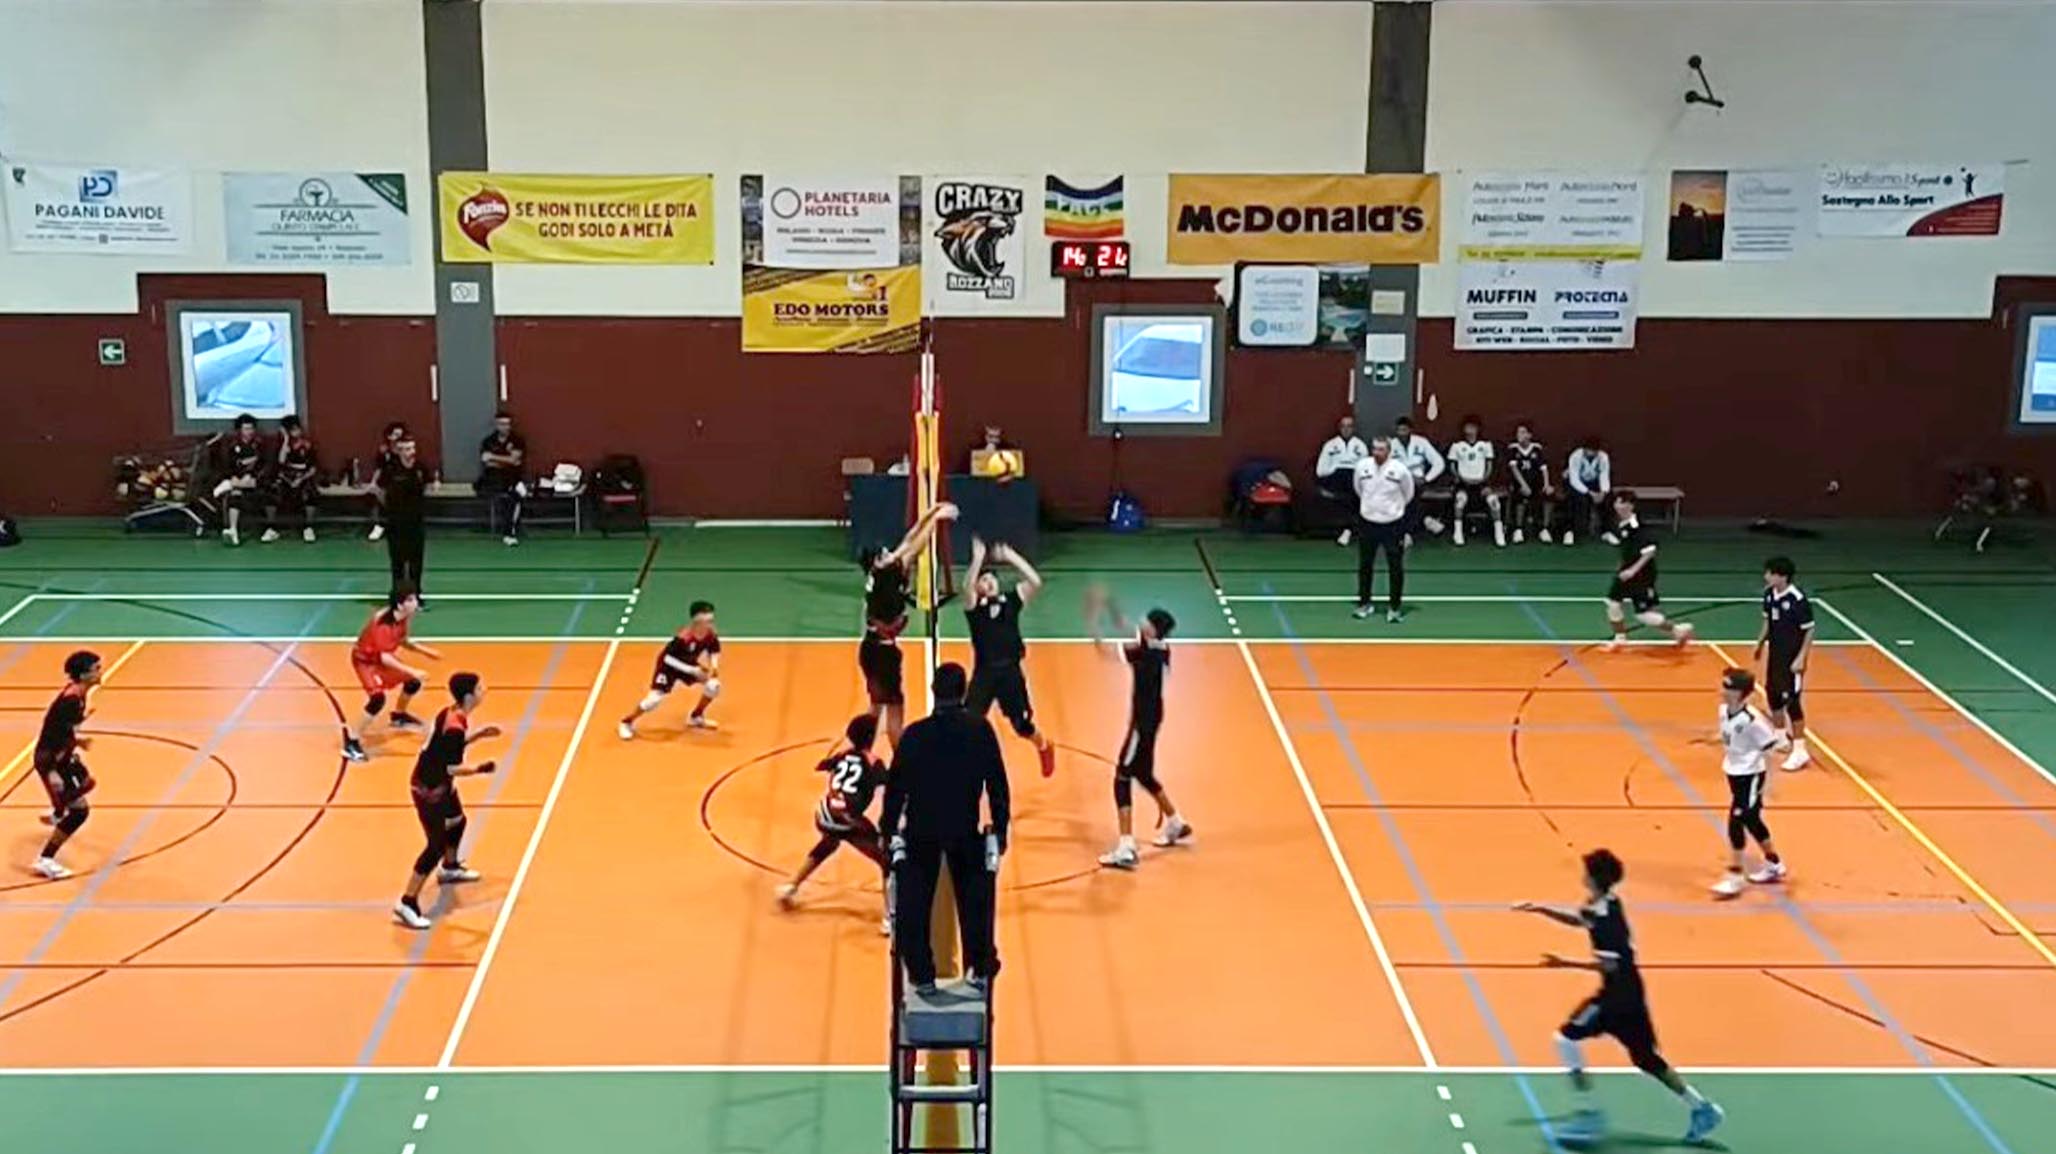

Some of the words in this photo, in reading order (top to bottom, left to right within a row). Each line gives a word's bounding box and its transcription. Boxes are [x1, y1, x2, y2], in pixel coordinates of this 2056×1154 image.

[805, 192, 891, 204] PLANETARIA
[939, 186, 1020, 215] CRAZY
[1878, 195, 1901, 206] Allo
[1904, 195, 1935, 208] Sport
[35, 203, 100, 218] PAGANI
[104, 205, 165, 220] DAVIDE
[280, 210, 354, 222] FARMACIA
[515, 203, 534, 218] SE
[539, 203, 571, 218] NON
[574, 203, 587, 218] TI
[590, 203, 640, 218] LECCHI
[644, 203, 661, 218] LE
[665, 203, 697, 218] DITA
[805, 206, 859, 217] HOTELS
[1177, 204, 1424, 233] McDonald's
[538, 223, 574, 238] GODI
[579, 223, 615, 238] SOLO
[619, 223, 630, 238] A
[634, 219, 674, 238] METÀ
[1467, 290, 1536, 304] MUFFIN
[774, 303, 810, 316] EDO
[814, 303, 889, 316] MOTORS
[832, 760, 863, 793] 22
